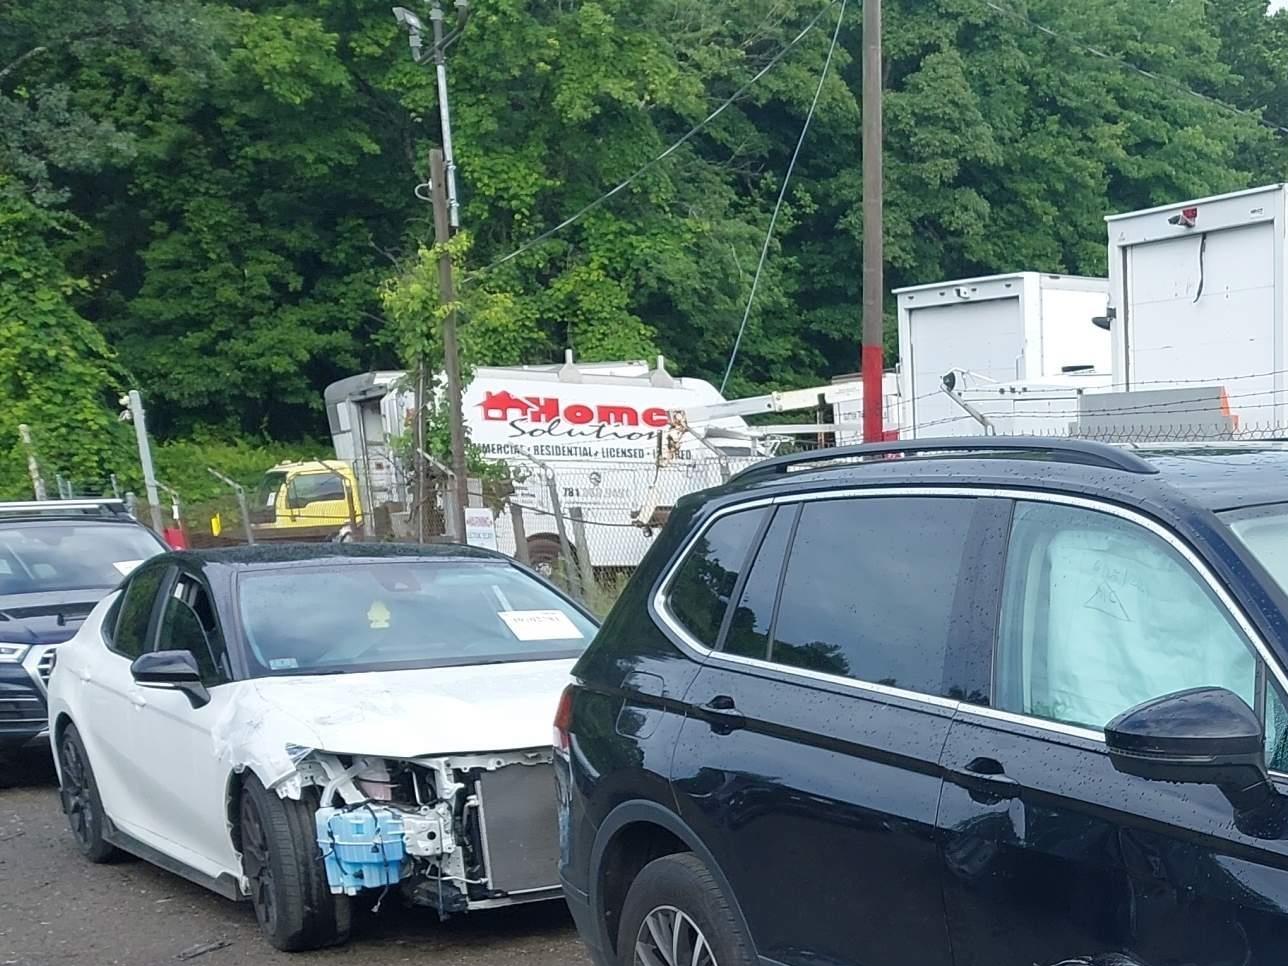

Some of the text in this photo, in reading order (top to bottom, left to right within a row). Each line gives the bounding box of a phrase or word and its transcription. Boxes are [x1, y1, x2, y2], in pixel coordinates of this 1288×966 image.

[525, 396, 670, 428] Home
[533, 444, 592, 457] RESIDENTIAL
[601, 447, 645, 459] LICENSED
[563, 487, 580, 497] 781
